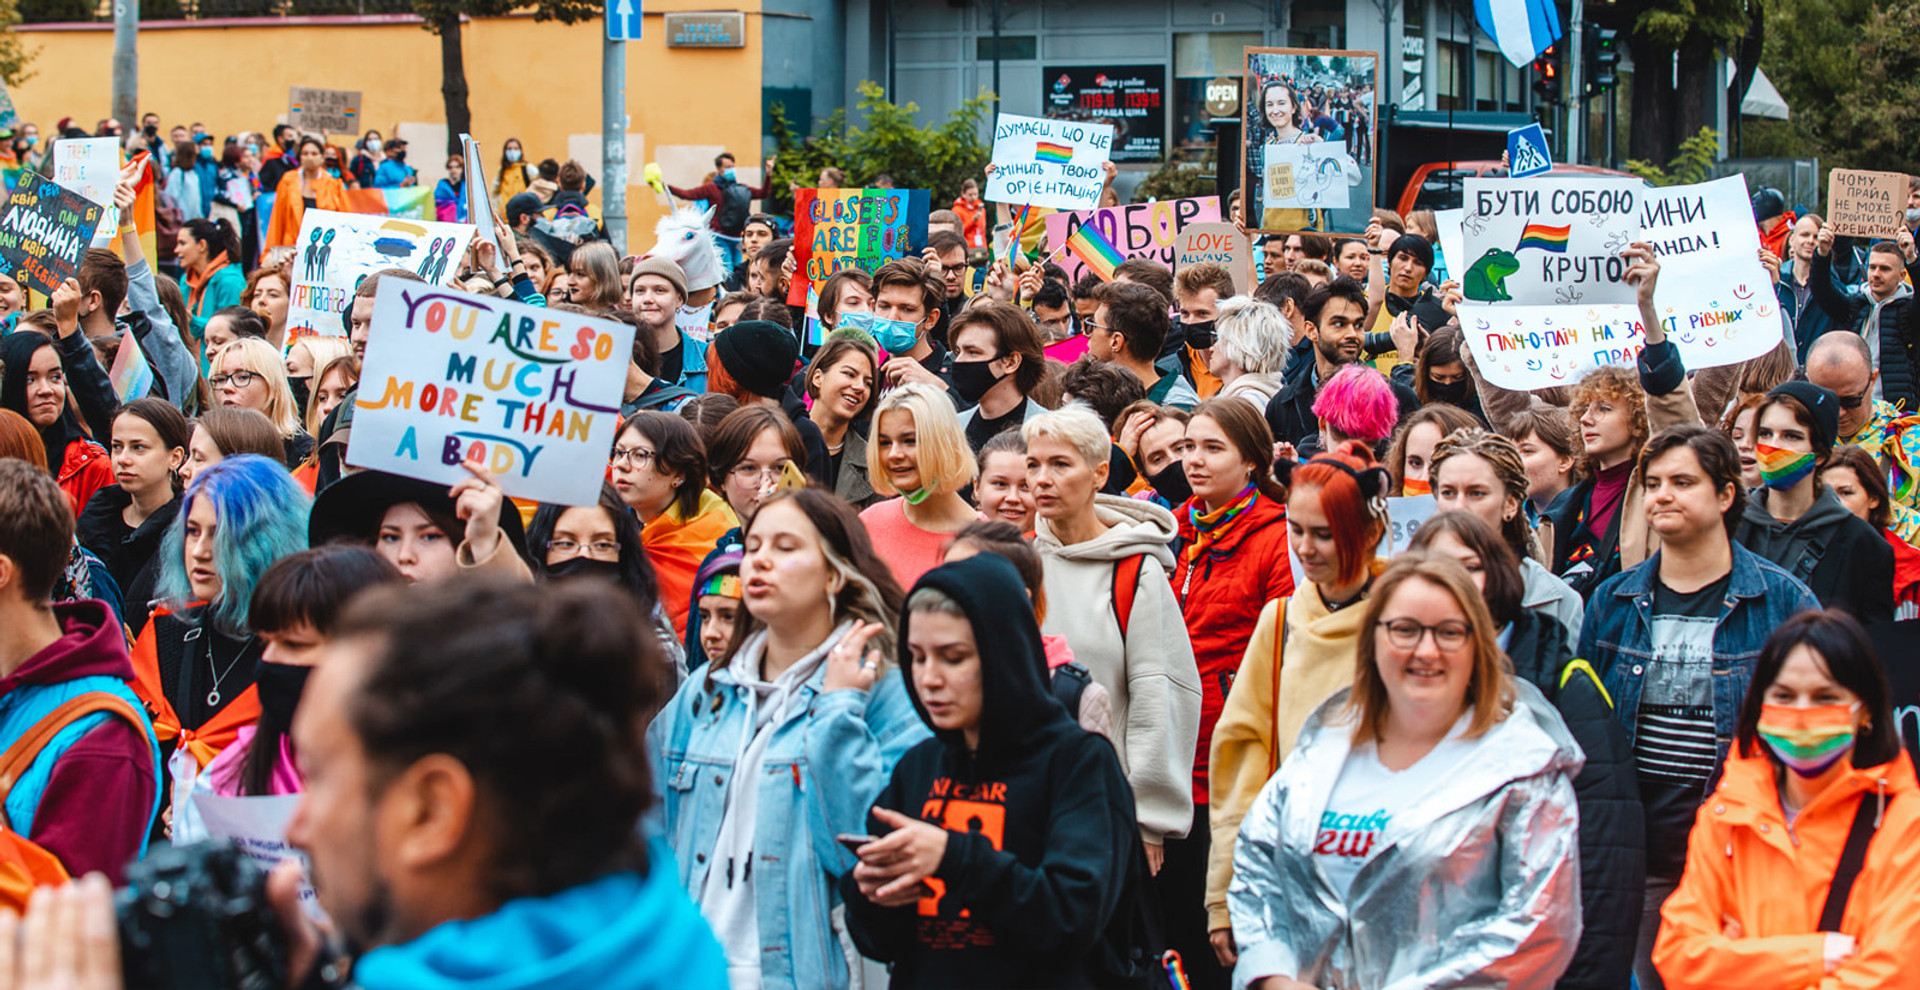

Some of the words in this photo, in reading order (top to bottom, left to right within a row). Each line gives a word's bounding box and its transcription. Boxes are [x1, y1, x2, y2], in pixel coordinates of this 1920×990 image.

[1206, 85, 1238, 102] OPEN
[1092, 108, 1124, 117] КРАЩА
[1062, 126, 1084, 142] ЩО
[1089, 132, 1110, 149] ЦЕ
[67, 145, 91, 160] TREAT
[60, 164, 85, 181] PEOPLE
[1061, 164, 1098, 179] ТВОЮ
[1837, 173, 1876, 187] ЧОМУ
[1477, 189, 1540, 216] БУТИ
[1551, 189, 1633, 215] СОБОЮ
[1847, 187, 1889, 201] ПРАЙД
[809, 195, 901, 226] CLOSETS
[1835, 199, 1850, 210] НЕ
[1857, 202, 1892, 213] МОЖЕ
[58, 210, 78, 227] ПАН
[1834, 211, 1875, 222] ПРОЙТИ
[1879, 215, 1893, 224] ПО
[2, 205, 80, 263] ЛЮДИНА
[811, 226, 857, 252] ARE
[866, 225, 913, 253] FOR
[1187, 233, 1234, 252] LOVE
[402, 289, 494, 341] YOU
[488, 312, 573, 364] ARE
[570, 327, 614, 361] SO
[1592, 324, 1614, 342] НА
[446, 352, 619, 414] MUCH
[355, 376, 484, 422] MORE
[496, 399, 595, 442] THAN
[394, 426, 419, 461] A
[441, 431, 544, 478] BODY
